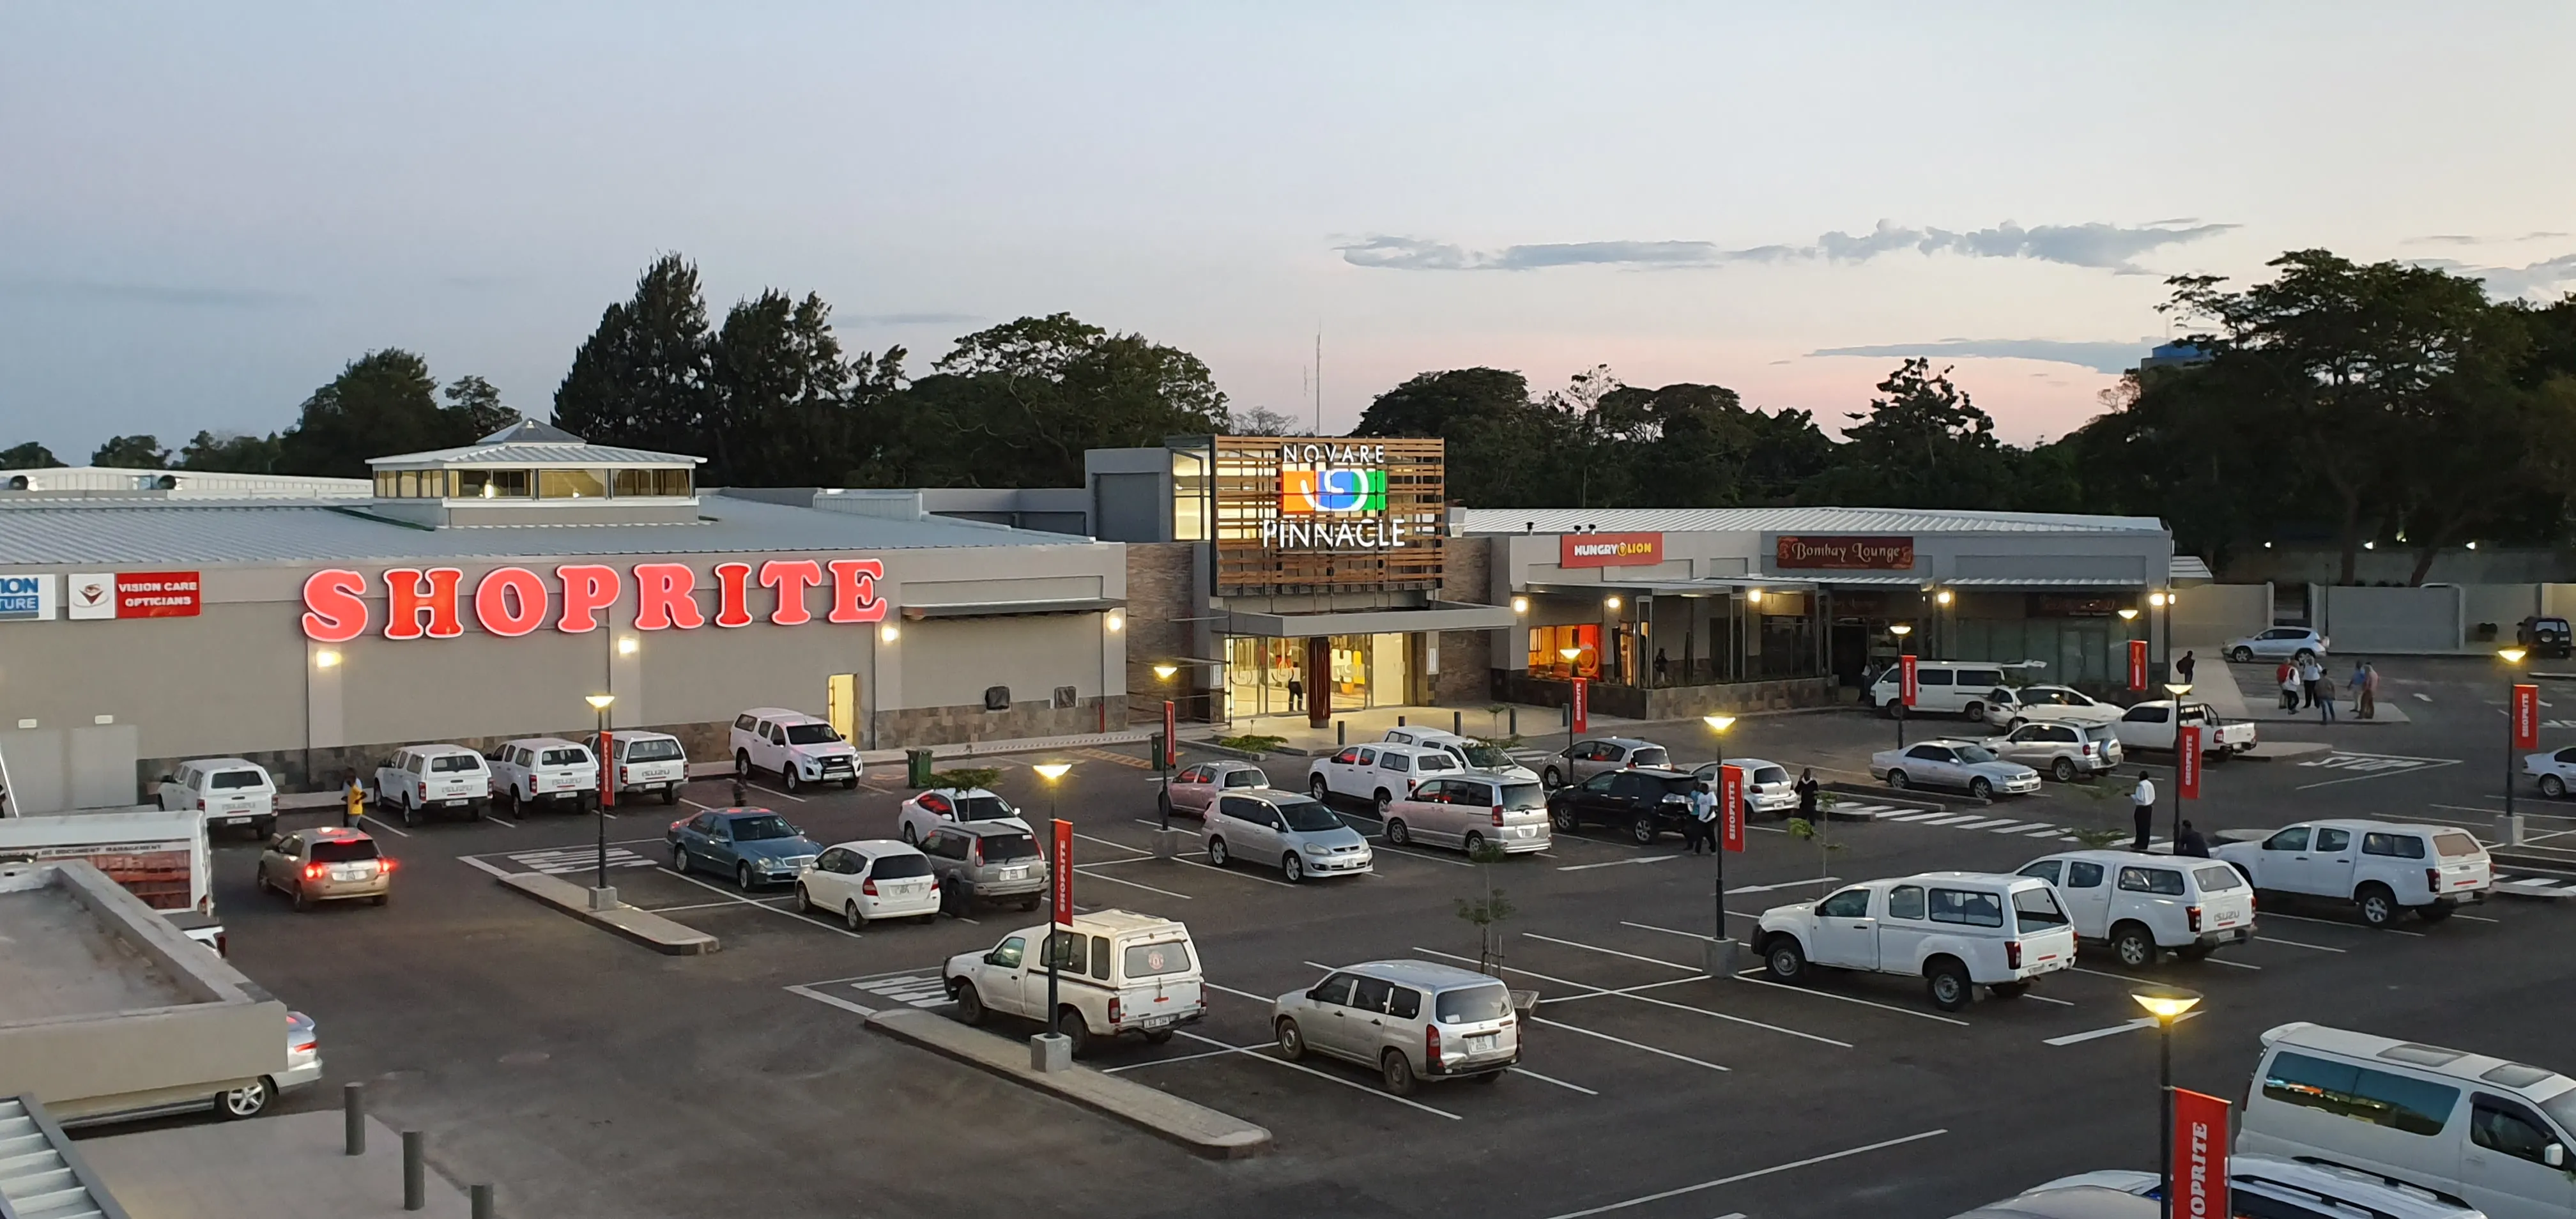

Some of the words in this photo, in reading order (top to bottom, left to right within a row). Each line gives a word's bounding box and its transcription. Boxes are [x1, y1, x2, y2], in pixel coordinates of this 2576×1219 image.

[1284, 445, 1384, 463] NOVARE
[1263, 519, 1406, 548] PINNACLE
[1574, 544, 1618, 556] HUNGRY
[1627, 543, 1652, 554] LION
[1791, 542, 1847, 563] Bombay
[1851, 542, 1901, 563] Lounge
[0, 578, 38, 594] ION
[118, 583, 161, 592] VISION
[164, 582, 197, 591] CARE
[125, 596, 192, 607] OPTICIANS
[302, 558, 888, 642] SHOPRITE
[2214, 910, 2240, 922] ISUZU
[2190, 1122, 2208, 1219] OPRITE
